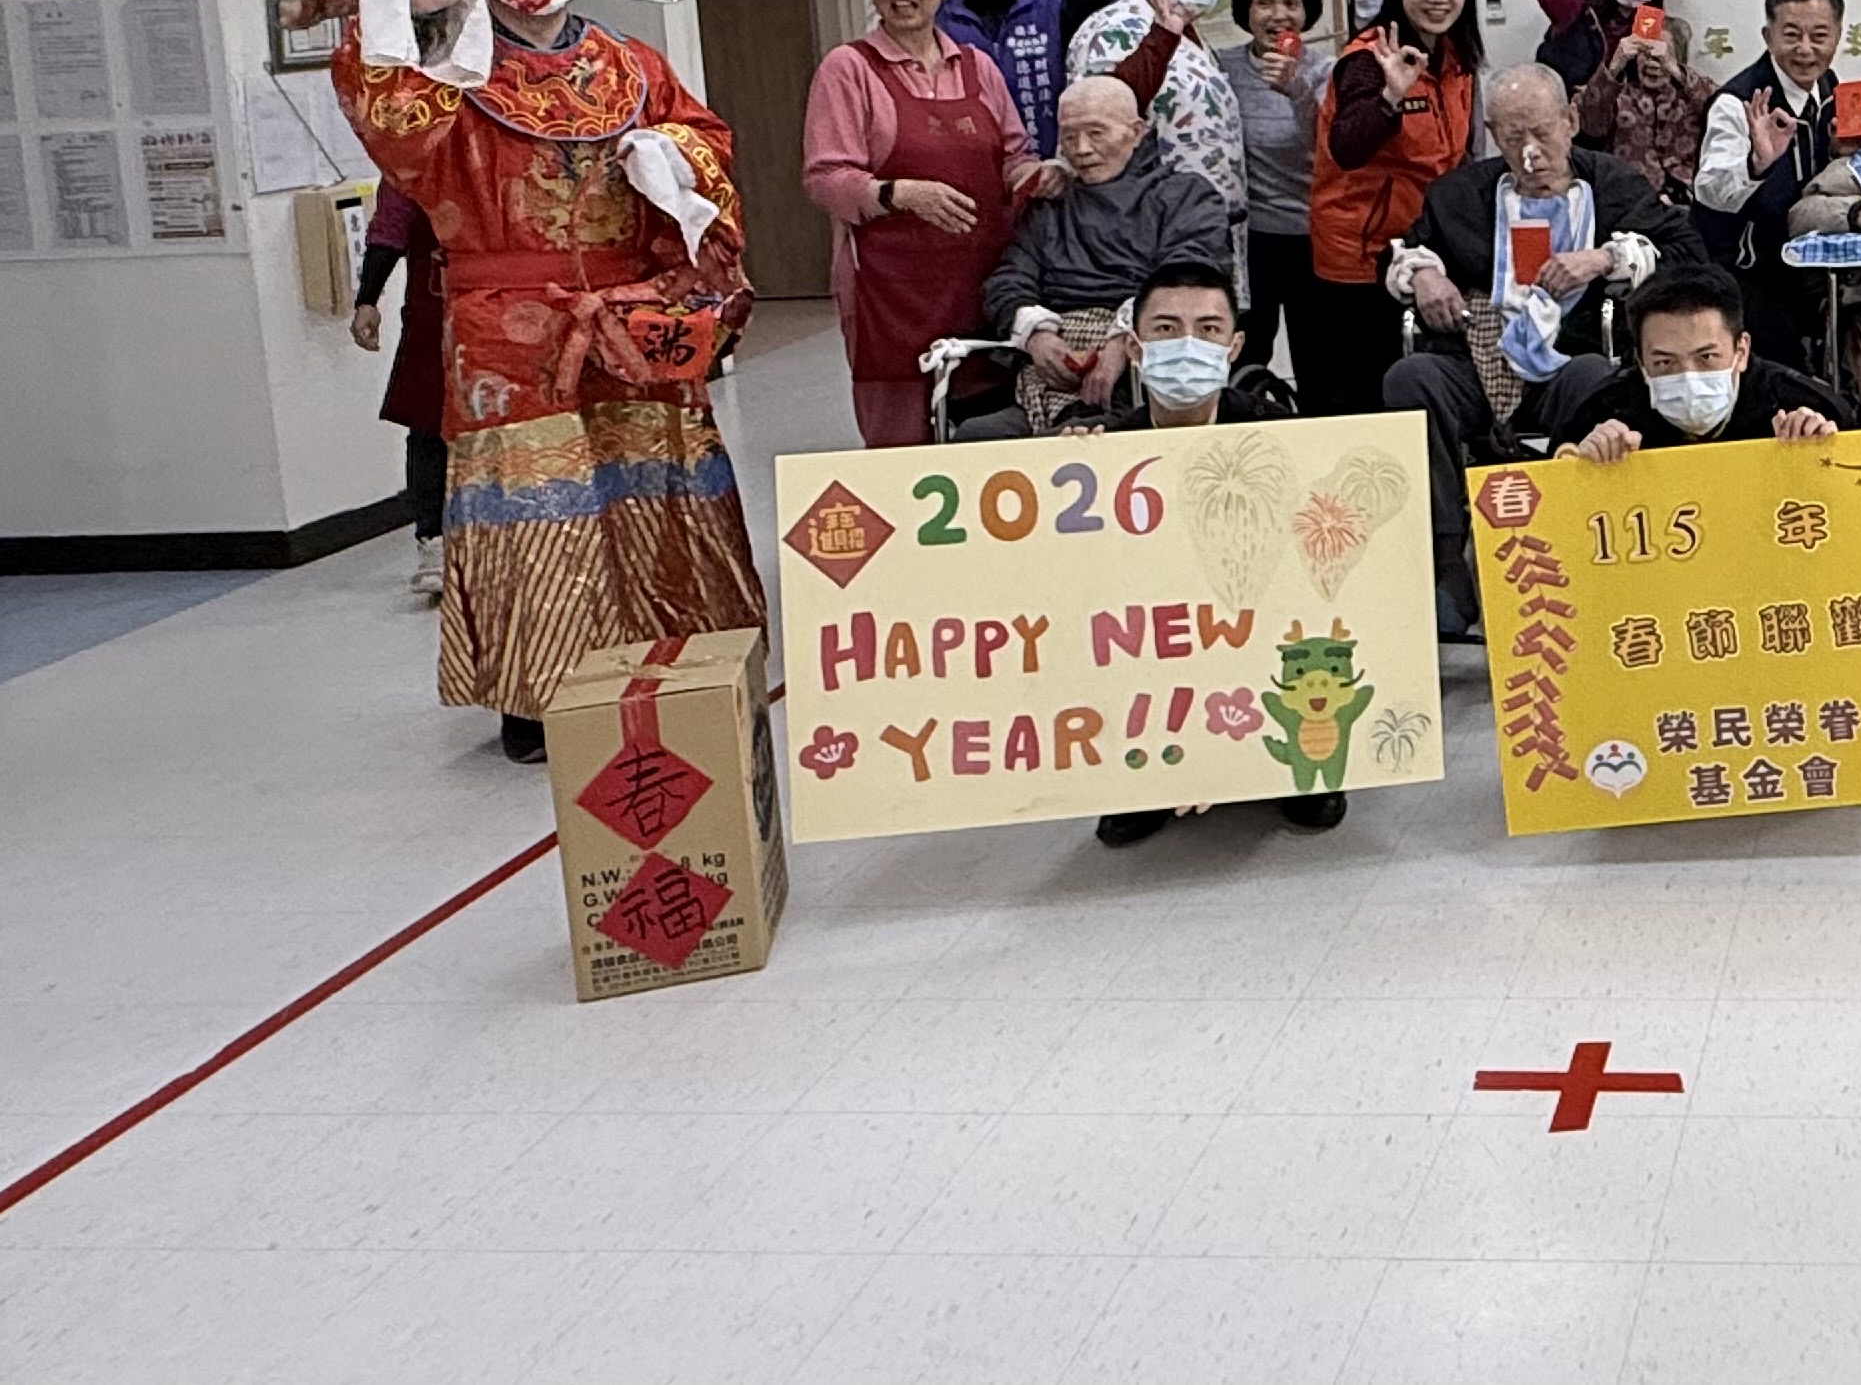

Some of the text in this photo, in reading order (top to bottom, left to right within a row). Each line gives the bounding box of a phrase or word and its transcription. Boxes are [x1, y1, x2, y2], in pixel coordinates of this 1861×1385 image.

[912, 455, 1165, 546] 2026
[1489, 476, 1533, 521] 春
[1588, 500, 1829, 565] 115 年
[820, 603, 1255, 691] HAPPY NEW
[1657, 699, 1861, 754] 榮民榮眷
[605, 743, 688, 838] 春
[1688, 755, 1839, 808] 基金會
[702, 852, 726, 868] kg
[620, 868, 707, 940] 福
